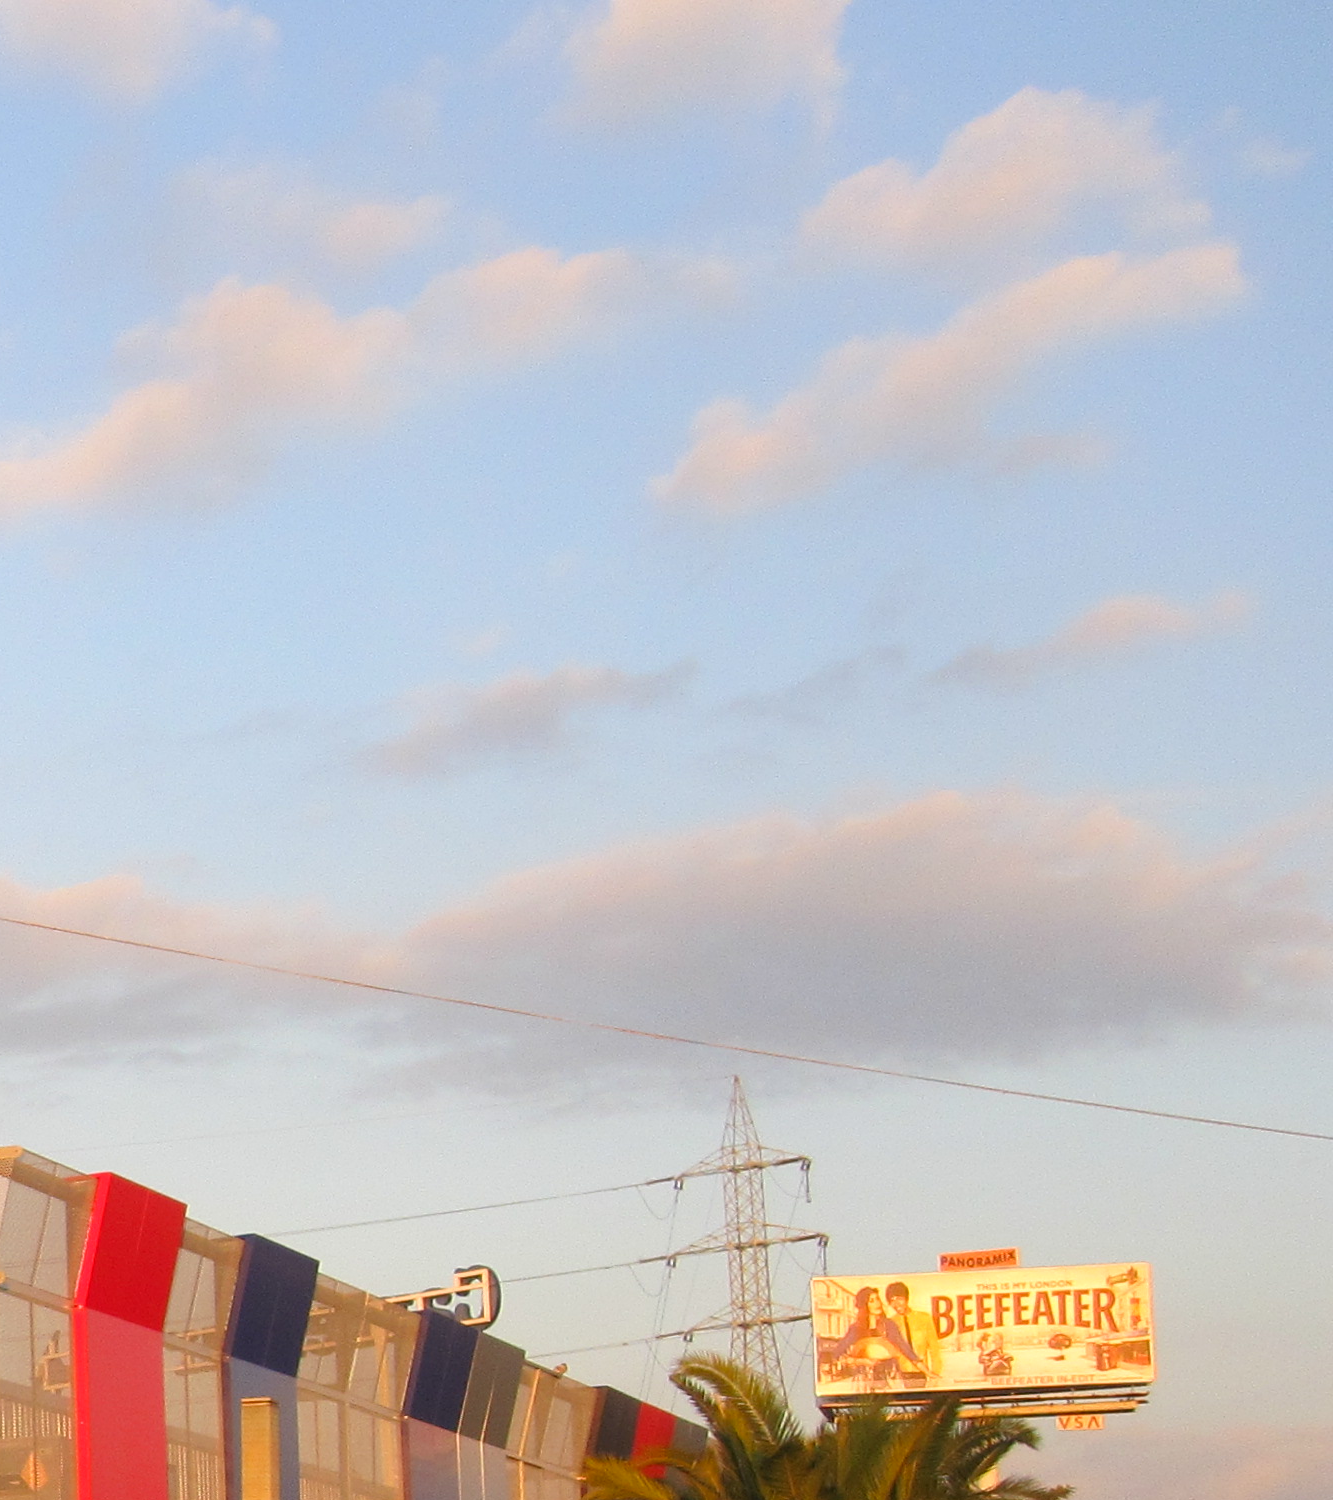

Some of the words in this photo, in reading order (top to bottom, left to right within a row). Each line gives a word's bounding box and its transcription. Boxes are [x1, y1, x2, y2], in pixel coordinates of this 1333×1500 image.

[940, 1252, 1016, 1268] PANORAMIX
[976, 1283, 998, 1291] THIS
[1000, 1282, 1010, 1290] IS
[1013, 1281, 1027, 1290] MY
[1029, 1280, 1074, 1289] LONDON
[931, 1288, 1120, 1340] BEEFEATER
[991, 1374, 1054, 1386] BEEFEATER
